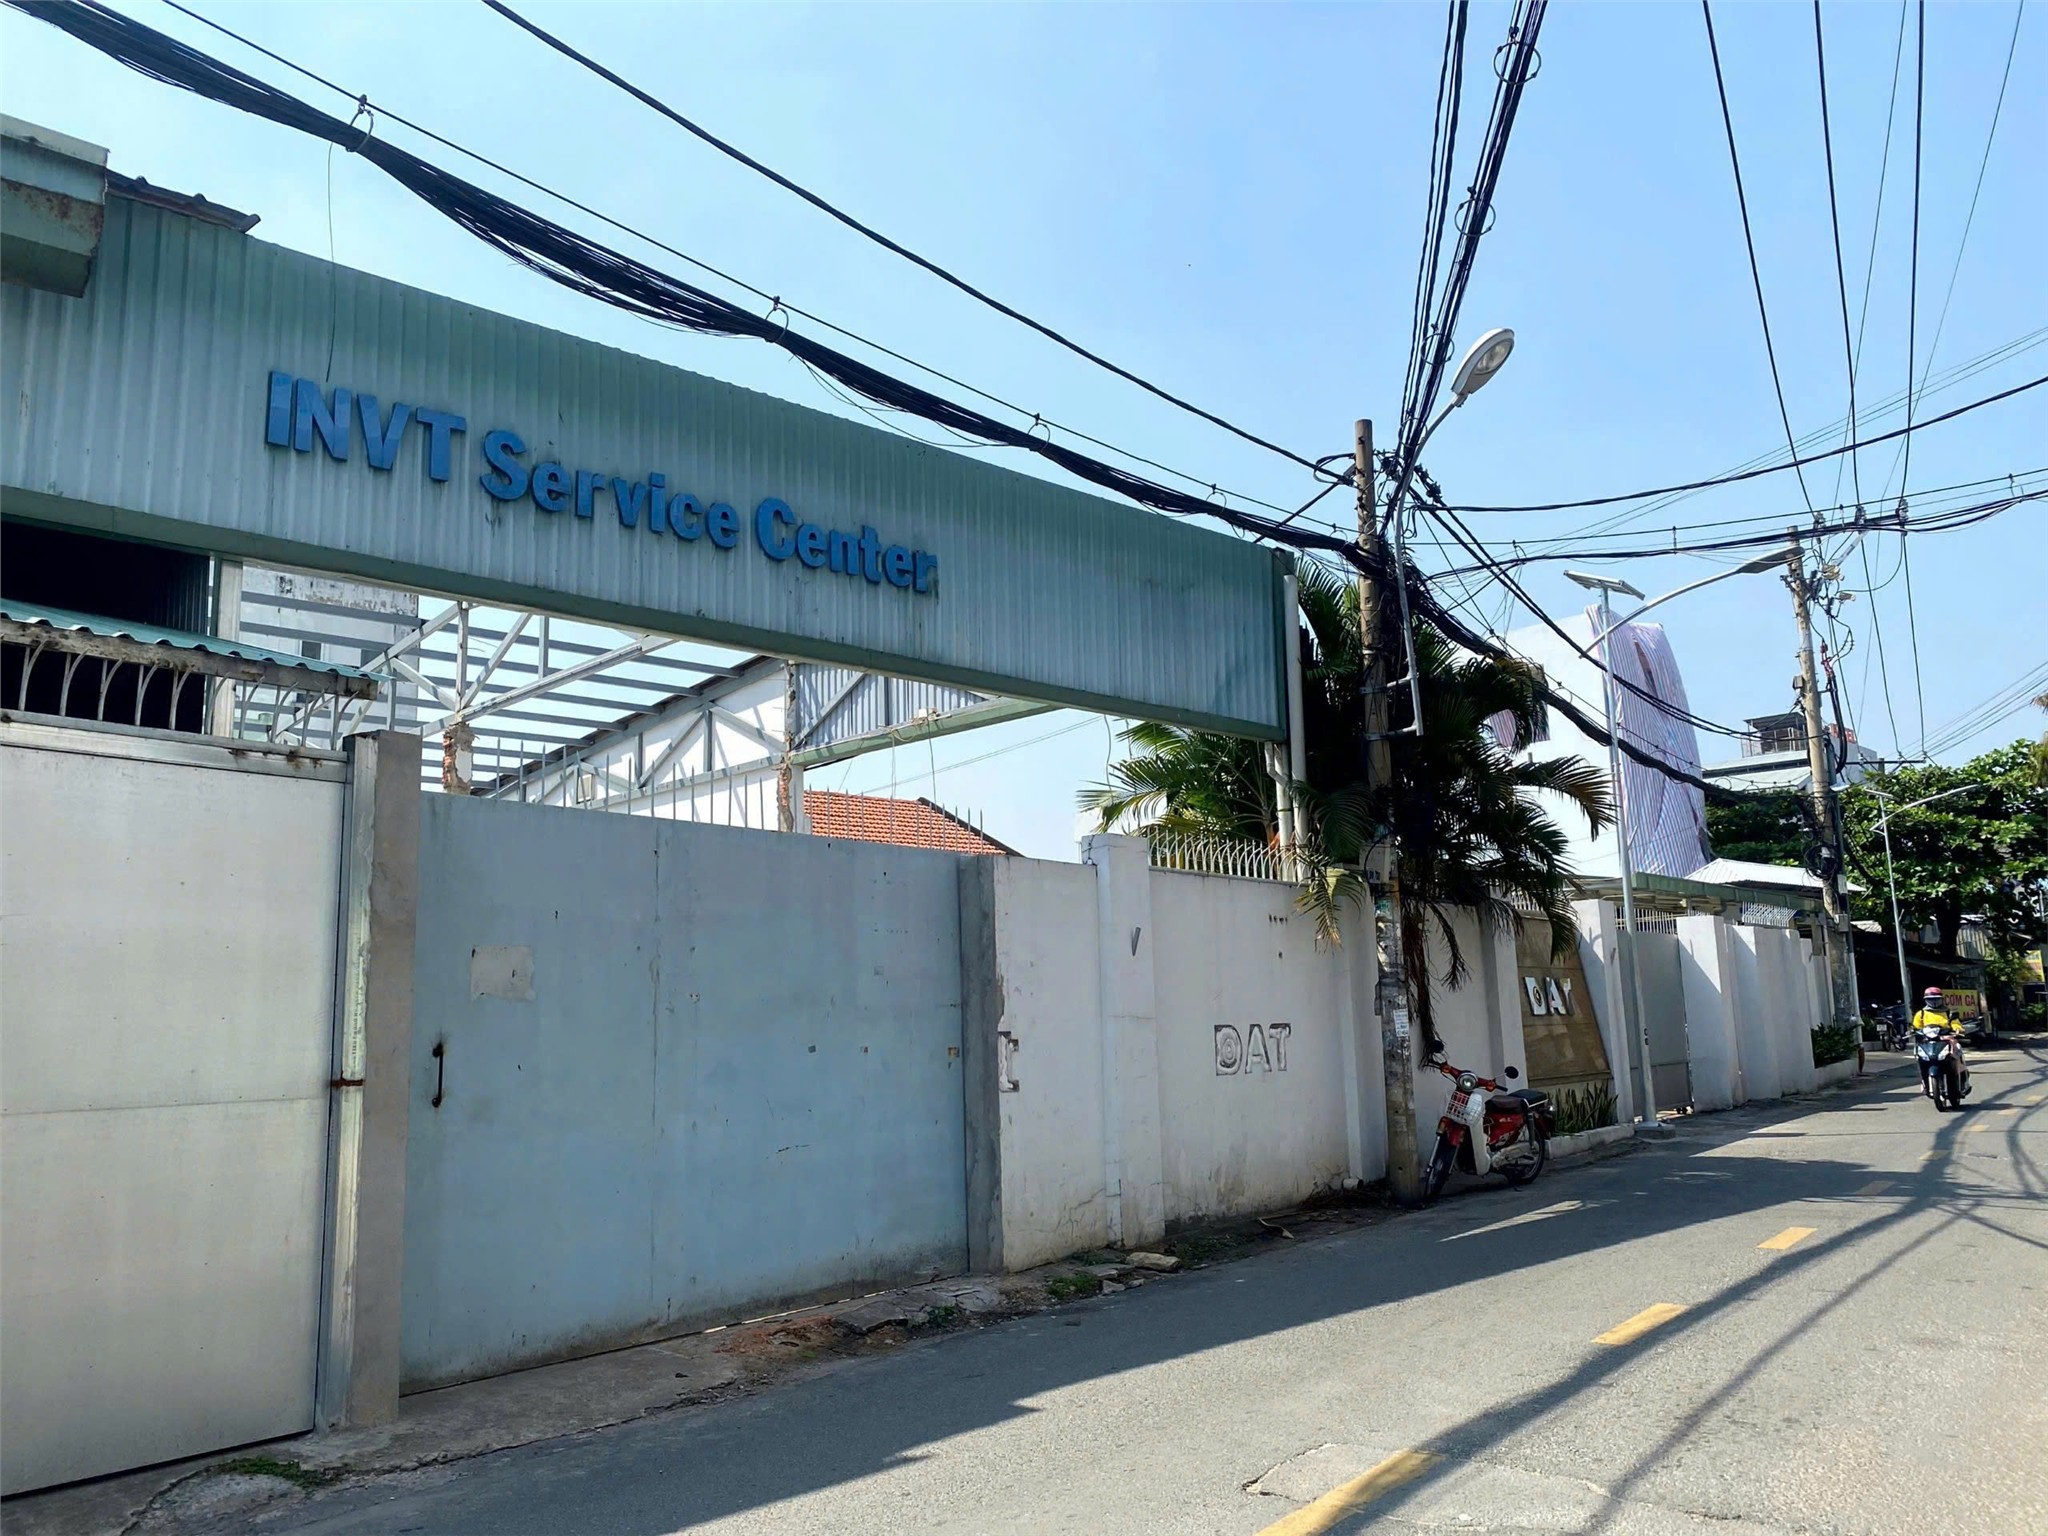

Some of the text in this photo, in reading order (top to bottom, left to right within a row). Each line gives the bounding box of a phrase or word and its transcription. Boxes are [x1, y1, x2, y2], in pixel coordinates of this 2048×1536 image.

[266, 371, 938, 594] INVT Service Center
[1214, 1022, 1291, 1076] DAT
